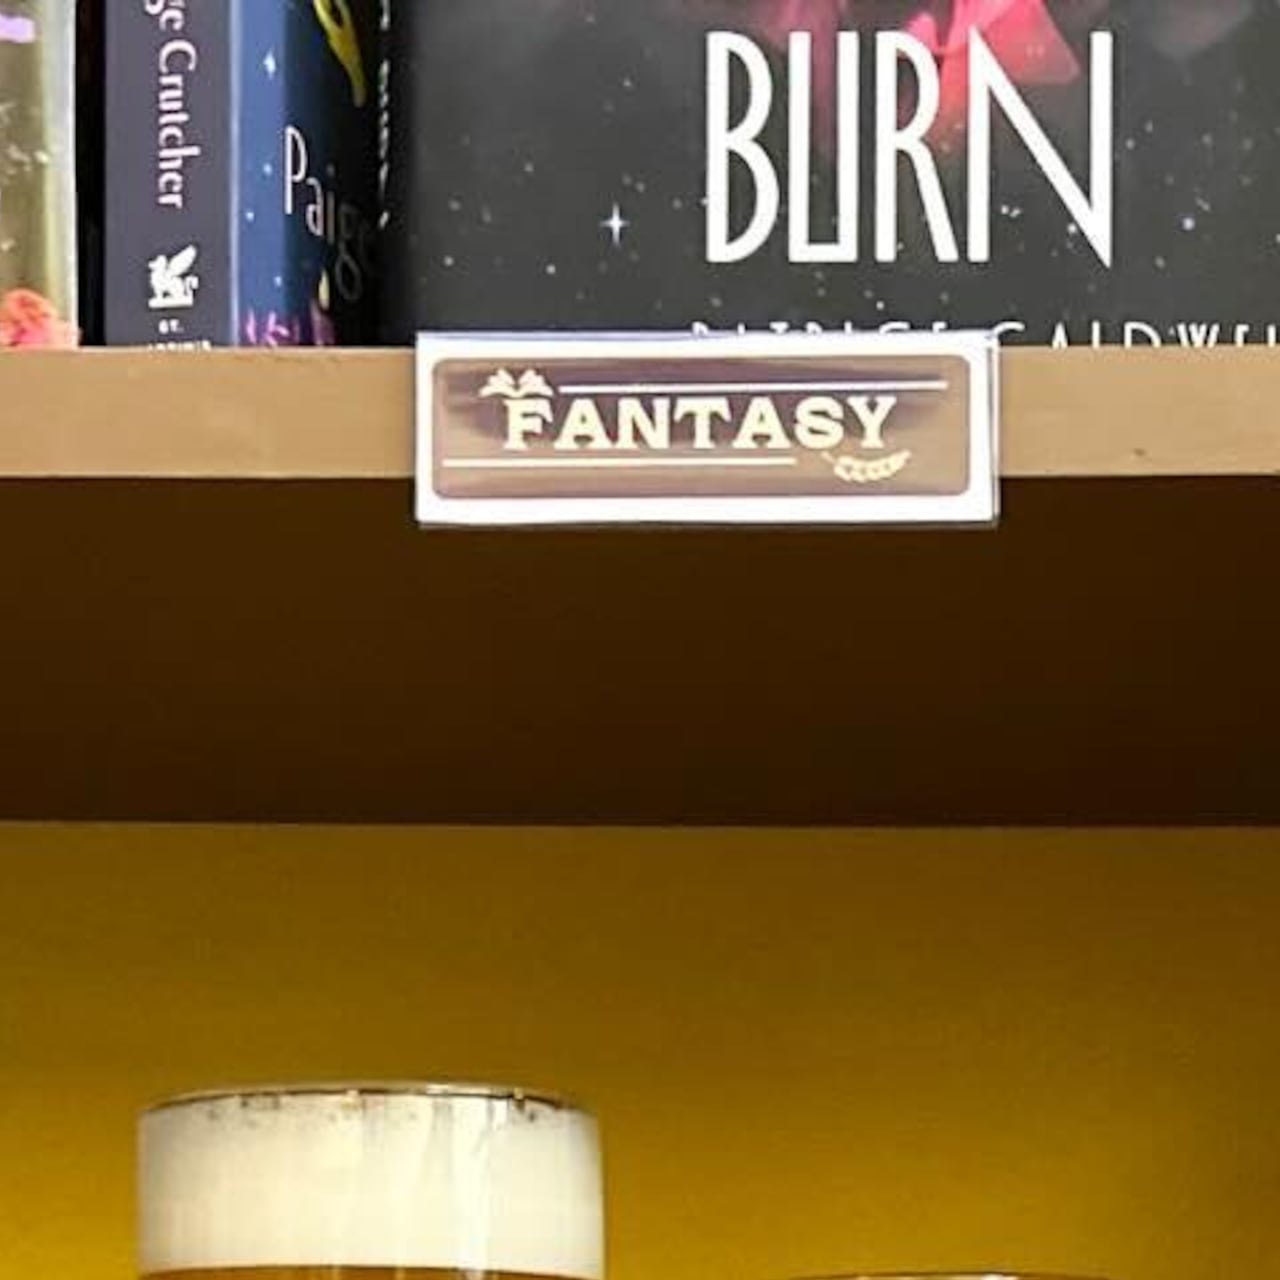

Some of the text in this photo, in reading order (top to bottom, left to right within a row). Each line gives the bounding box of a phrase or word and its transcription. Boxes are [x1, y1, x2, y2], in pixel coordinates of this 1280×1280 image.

[157, 48, 202, 209] Crutcher
[704, 29, 1114, 268] BURN
[502, 395, 898, 453] FANTASY
